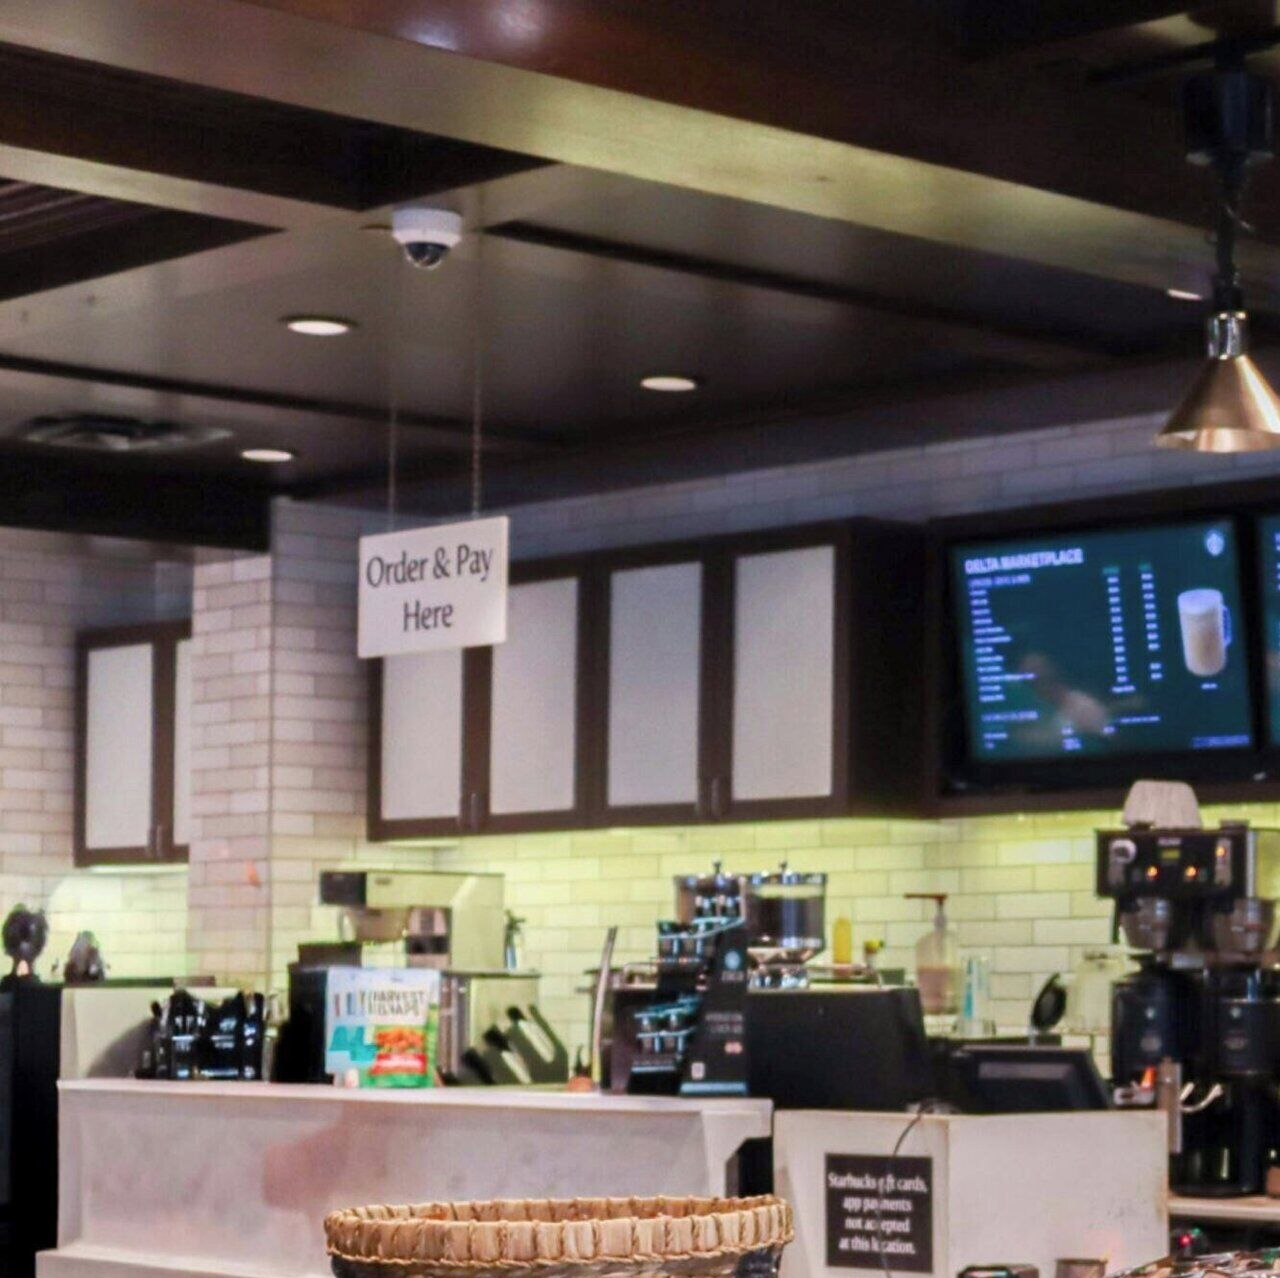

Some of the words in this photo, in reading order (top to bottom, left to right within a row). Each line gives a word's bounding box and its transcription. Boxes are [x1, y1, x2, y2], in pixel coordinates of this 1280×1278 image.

[366, 551, 428, 588] Order
[433, 547, 449, 580] &
[457, 544, 493, 582] Pay
[403, 601, 453, 631] Here
[828, 1172, 876, 1189] Starbucks
